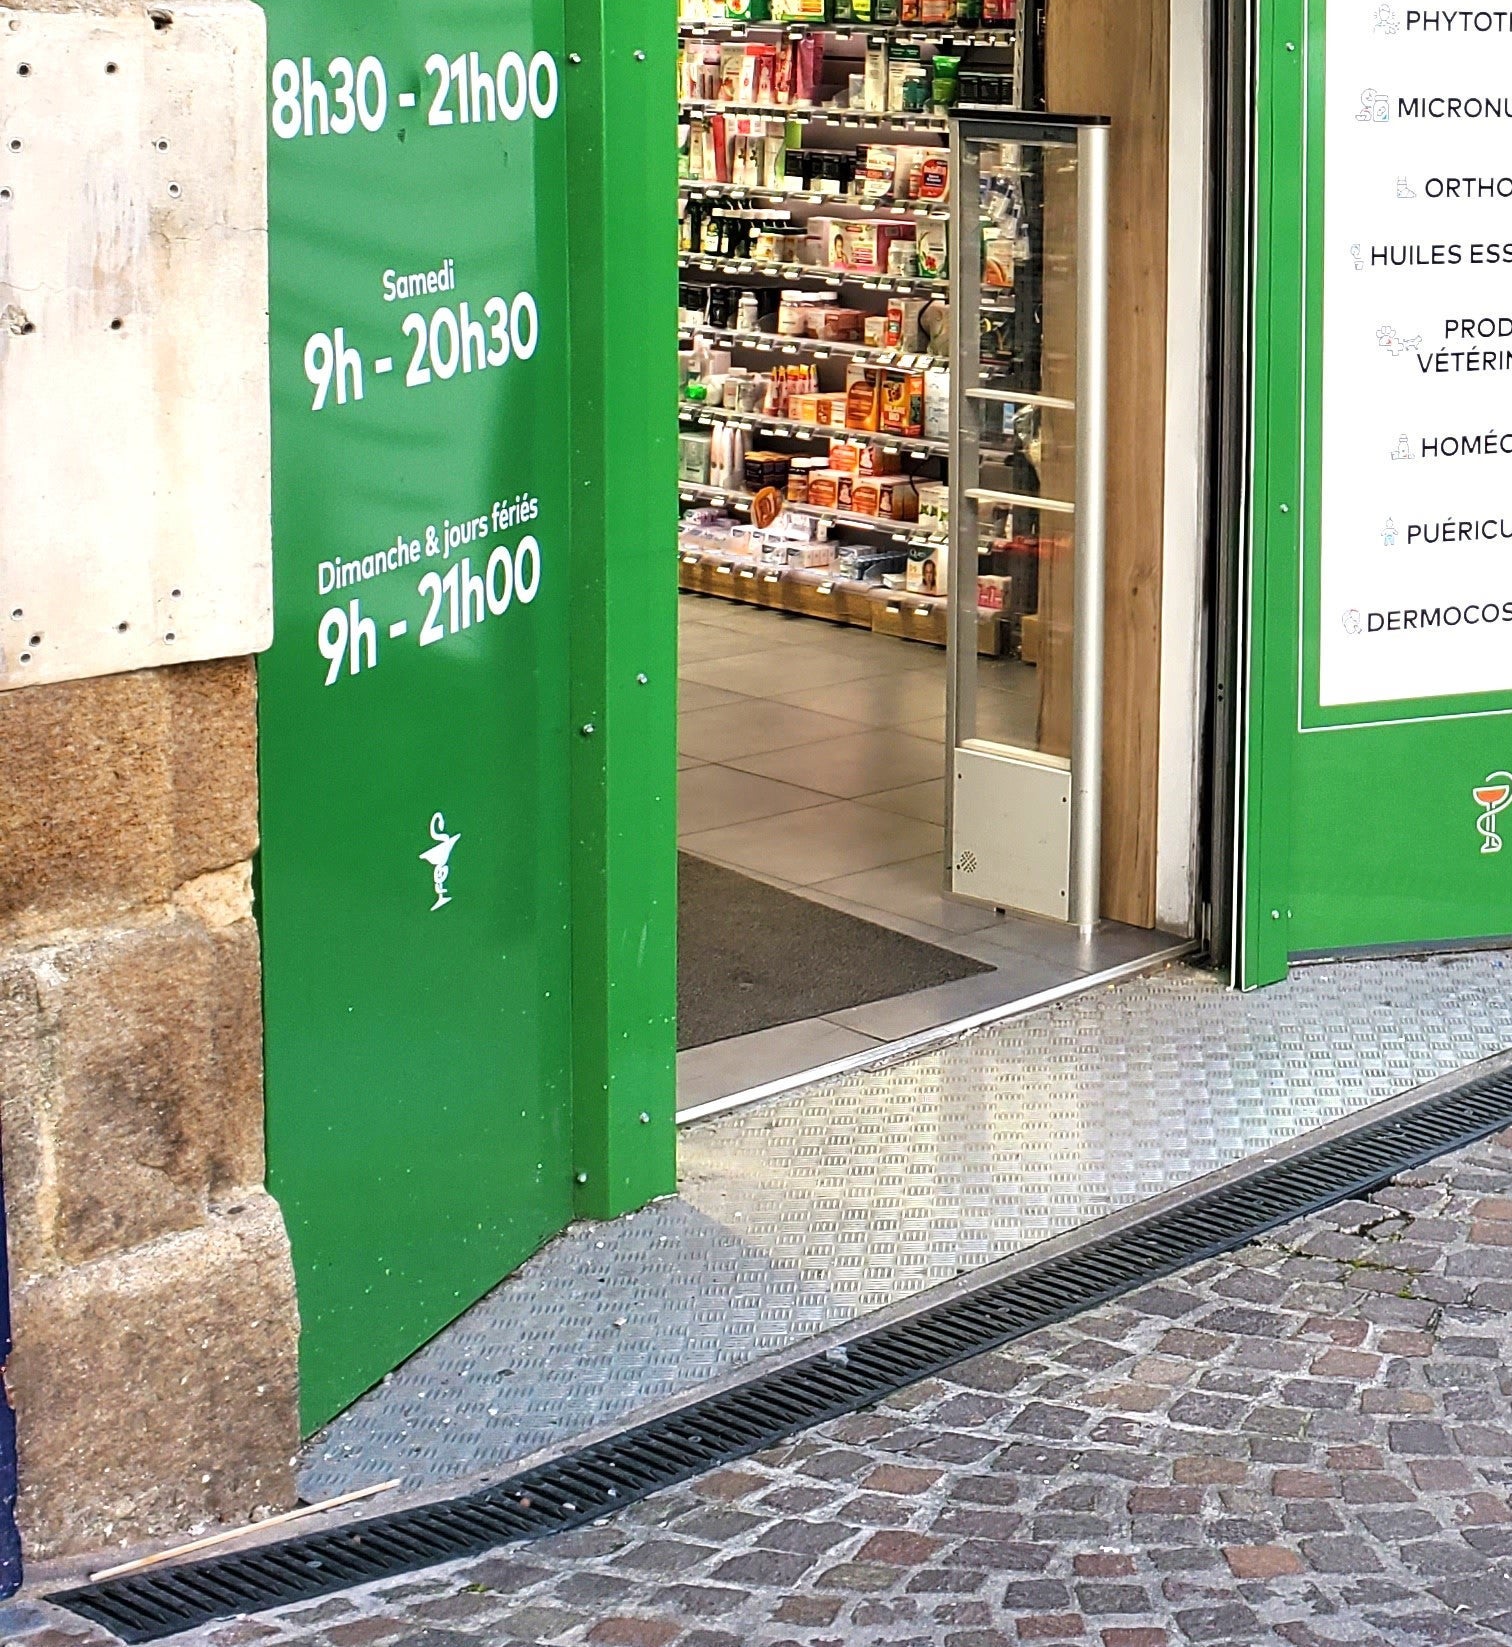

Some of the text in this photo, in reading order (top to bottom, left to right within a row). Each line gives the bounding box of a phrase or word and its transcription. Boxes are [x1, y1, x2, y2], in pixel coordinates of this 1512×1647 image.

[271, 50, 558, 140] 8h30 - 21h00
[382, 258, 455, 302] Samedi
[1370, 244, 1462, 266] HUILES
[304, 291, 539, 411] 9h - 20h30
[319, 493, 539, 595] Dimanche & jours fériés
[318, 535, 541, 686] 9h - 21h00
